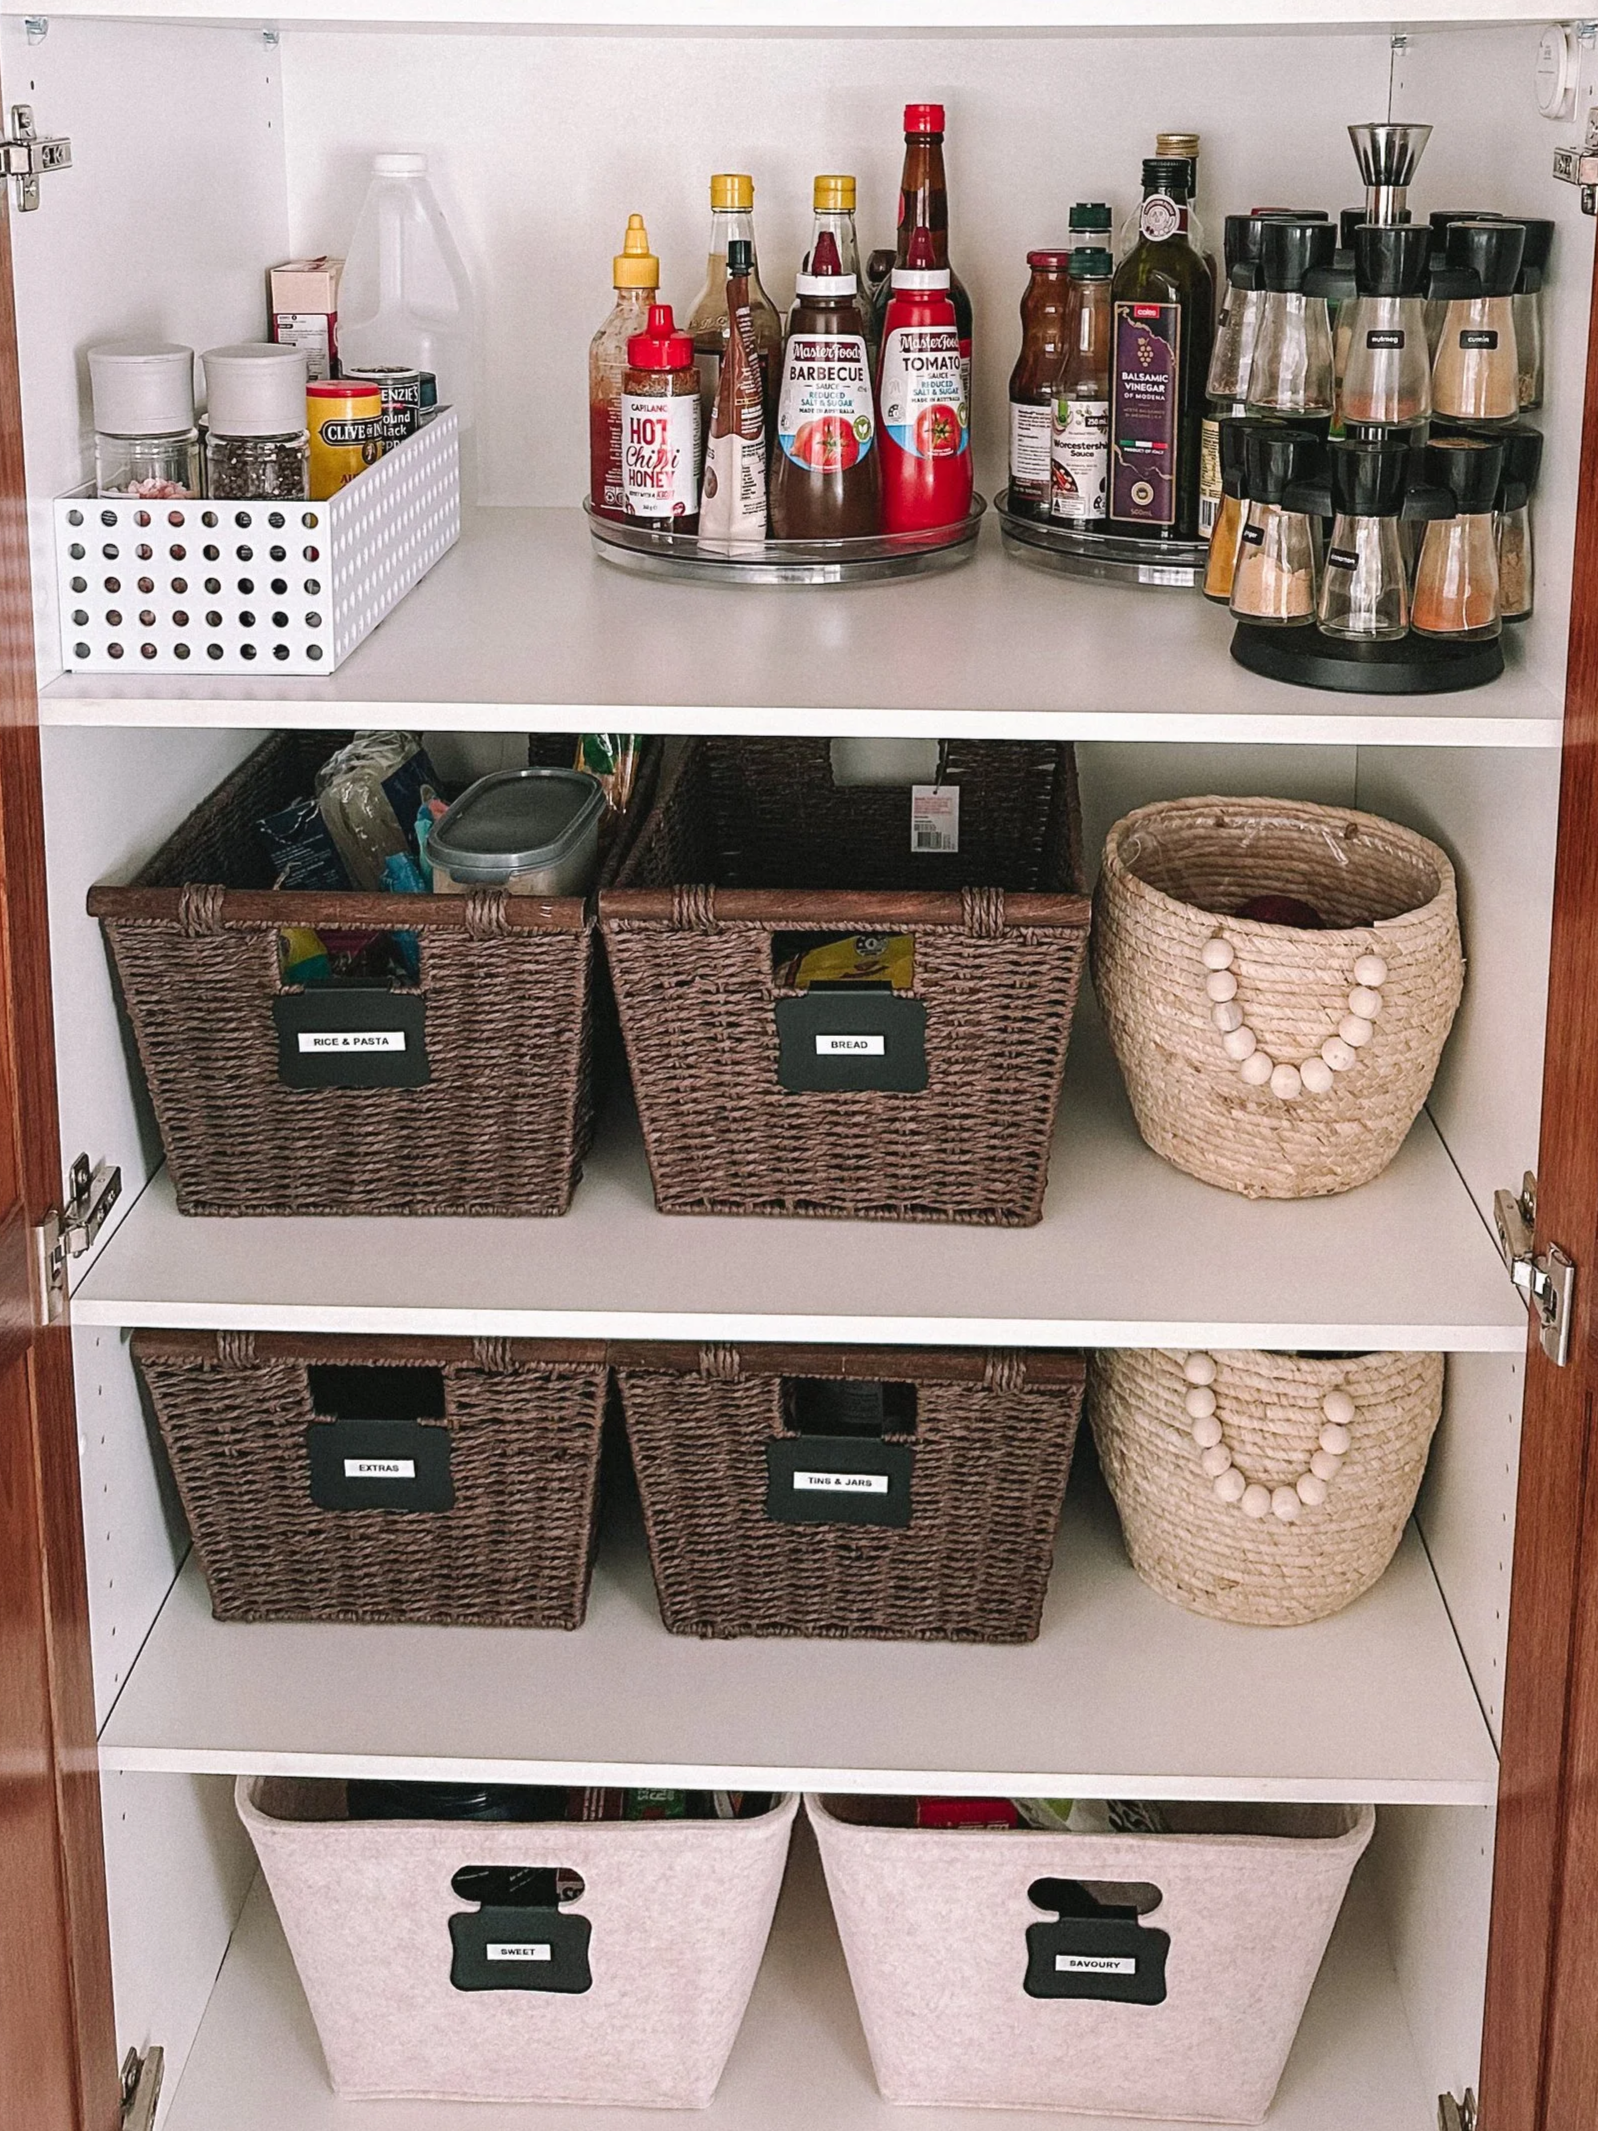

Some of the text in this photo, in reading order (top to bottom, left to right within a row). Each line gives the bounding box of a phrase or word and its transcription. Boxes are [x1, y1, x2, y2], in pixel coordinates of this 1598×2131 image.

[1137, 308, 1157, 316] coles
[1371, 336, 1399, 344] nutmeg
[1467, 335, 1490, 343] cumin
[902, 355, 961, 371] TOMATO
[790, 366, 864, 382] BARBECUE
[1121, 372, 1169, 383] BALSAMIC
[921, 380, 954, 388] REDUCED
[1124, 382, 1166, 393] VINEGAR
[381, 385, 419, 402] ENZIE'S
[809, 391, 846, 399] REDUCED
[913, 388, 930, 396] SALT
[1135, 393, 1166, 401] MODENA
[383, 411, 411, 424] ound
[327, 425, 366, 441] CLIVE
[384, 424, 407, 437] lack
[630, 416, 668, 446] HOT
[1070, 449, 1095, 458] Sauce
[628, 468, 676, 489] HONEY
[313, 1037, 390, 1046] RICE & PASTA
[830, 1041, 868, 1049] BREAD
[359, 1464, 400, 1472] EXTRAS
[808, 1477, 831, 1485] TINS
[845, 1478, 872, 1487] JARS
[500, 1948, 536, 1956] SWEET
[1069, 1960, 1121, 1969] SAVOURY
